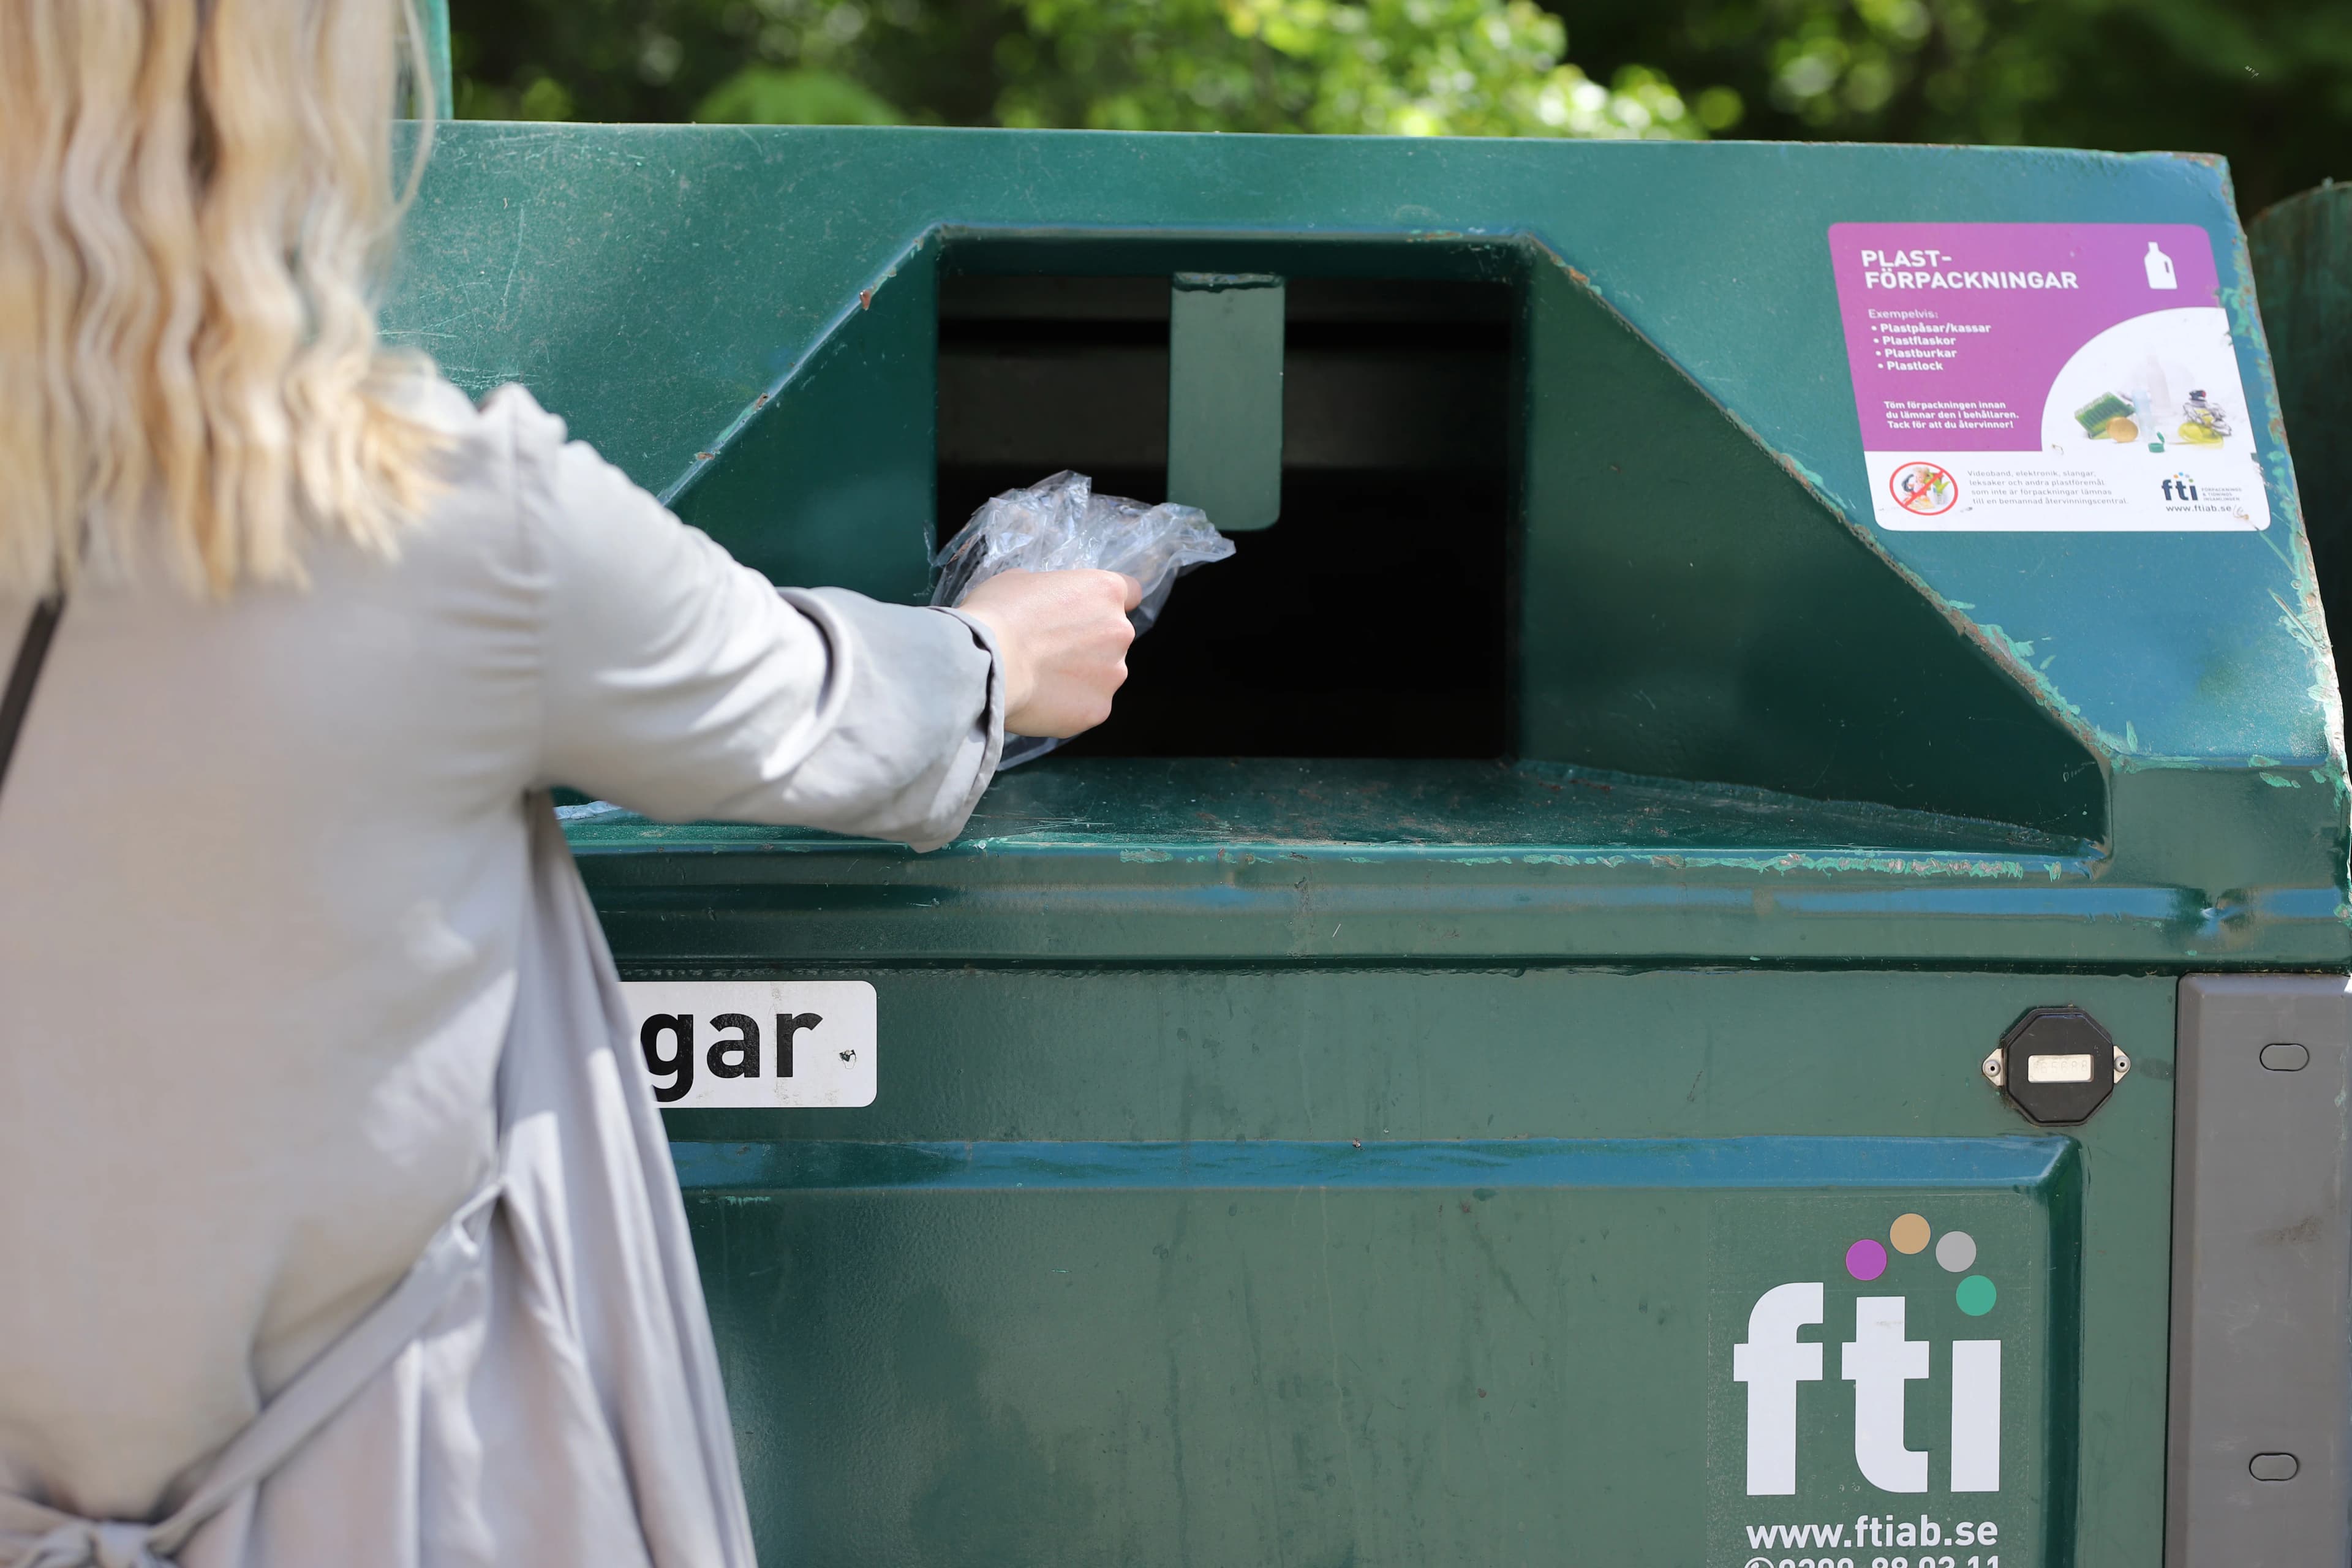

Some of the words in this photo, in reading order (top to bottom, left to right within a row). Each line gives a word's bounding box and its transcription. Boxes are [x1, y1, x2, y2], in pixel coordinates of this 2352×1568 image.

[1861, 250, 1952, 268] PLAST-
[1864, 267, 2079, 289] FÖRPACKNINGAR
[1868, 309, 1939, 321] Exempelvis:
[1880, 322, 1992, 335] Plastpåsar/kassar
[1882, 336, 1956, 345] Plastflaskor
[1884, 348, 1958, 358] Plastburkar
[1887, 361, 1943, 371] Plastlock
[1883, 401, 1905, 409] Töm
[1907, 400, 1977, 410] förpackningen
[1979, 401, 2007, 409] innan
[1886, 410, 1899, 419] du
[1900, 410, 1936, 419] lämnar
[1963, 409, 2019, 419] behållaren.
[1887, 420, 1910, 429] Tack
[1912, 420, 1927, 429] för
[1944, 420, 1958, 429] du
[1958, 419, 2015, 429] återvinner!
[2052, 478, 2105, 488] plastföremål
[2020, 488, 2079, 497] förpackningar
[2161, 478, 2198, 501] fti
[1733, 1281, 2001, 1496] fti
[1746, 1514, 1998, 1550] www.ftiab.se
